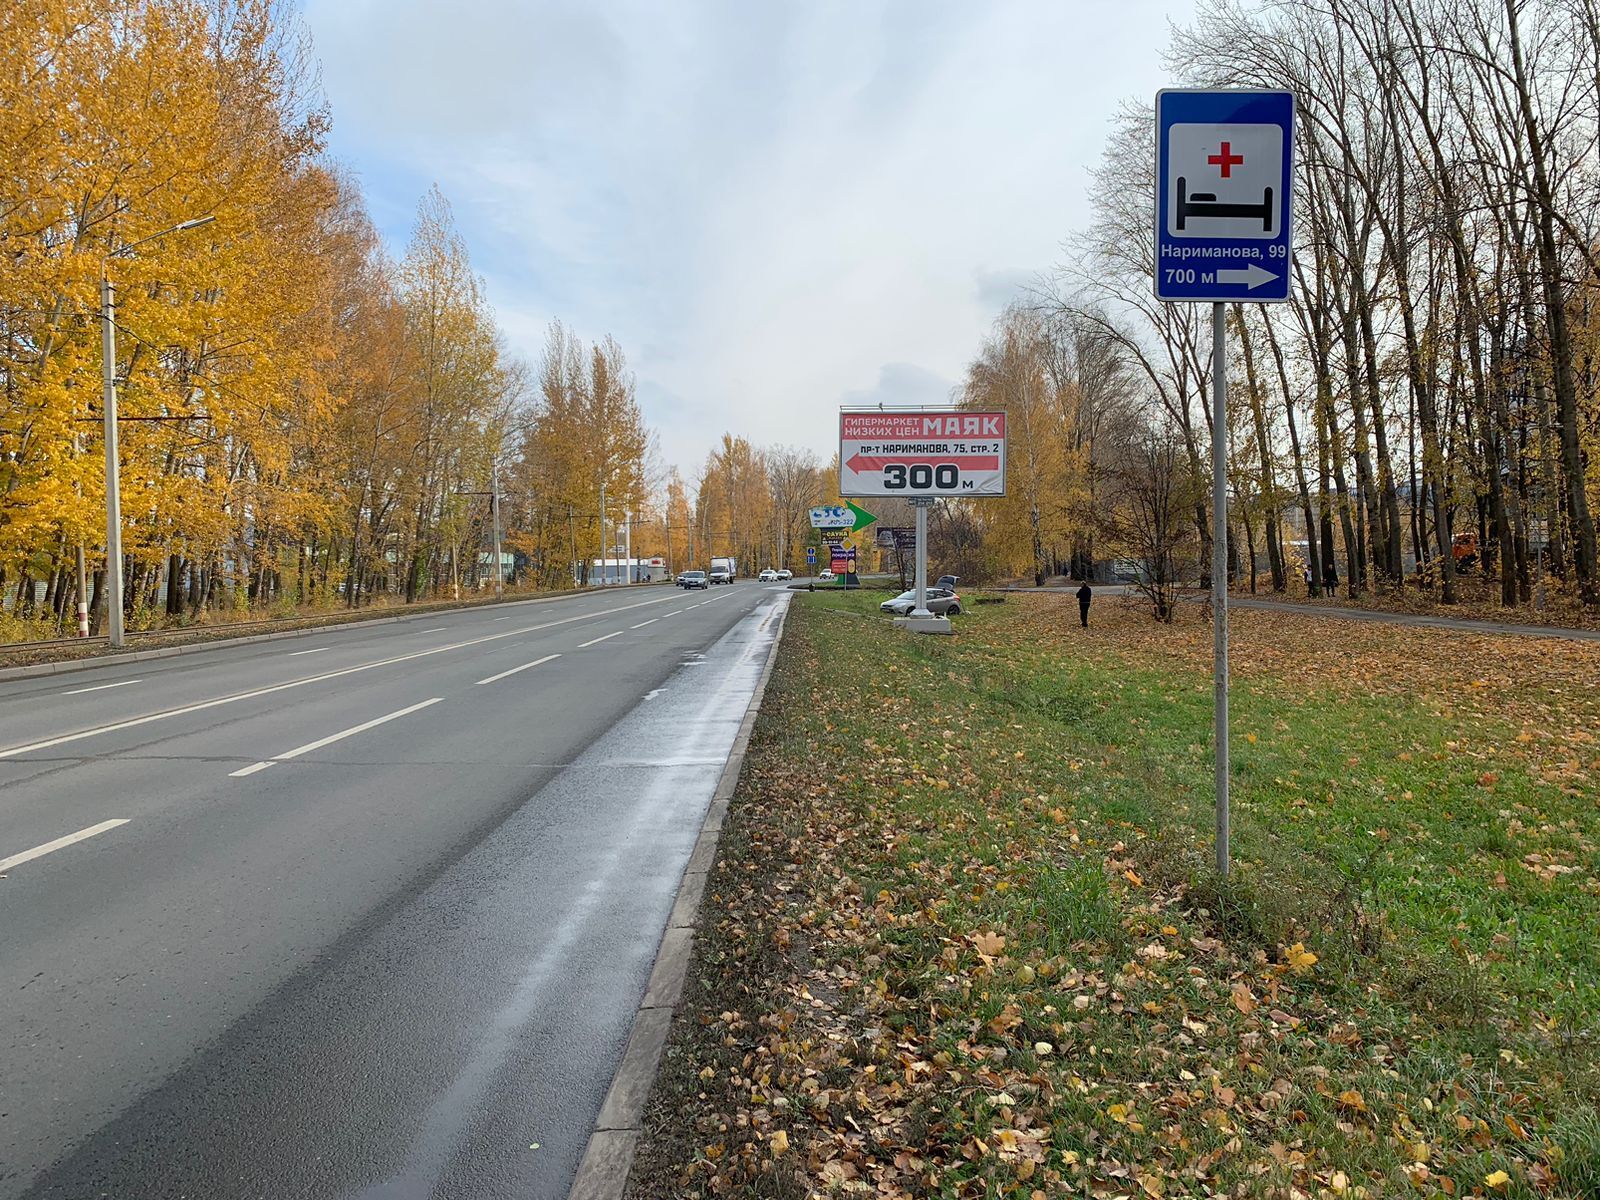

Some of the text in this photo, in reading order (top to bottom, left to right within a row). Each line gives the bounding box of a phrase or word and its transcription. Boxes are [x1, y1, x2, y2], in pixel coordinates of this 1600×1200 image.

[1161, 244, 1287, 261] Нариманова, 99
[1165, 269, 1214, 284] 700 м
[845, 417, 920, 426] ГИПЕРМАРКЕТ
[923, 417, 1000, 436] МАЯК
[845, 427, 920, 437] НИЗКИХ ЦЕН
[882, 444, 951, 454] НАРИМАНОВА,
[953, 444, 968, 454] 75,
[992, 443, 999, 453] 2
[884, 464, 959, 489] 300
